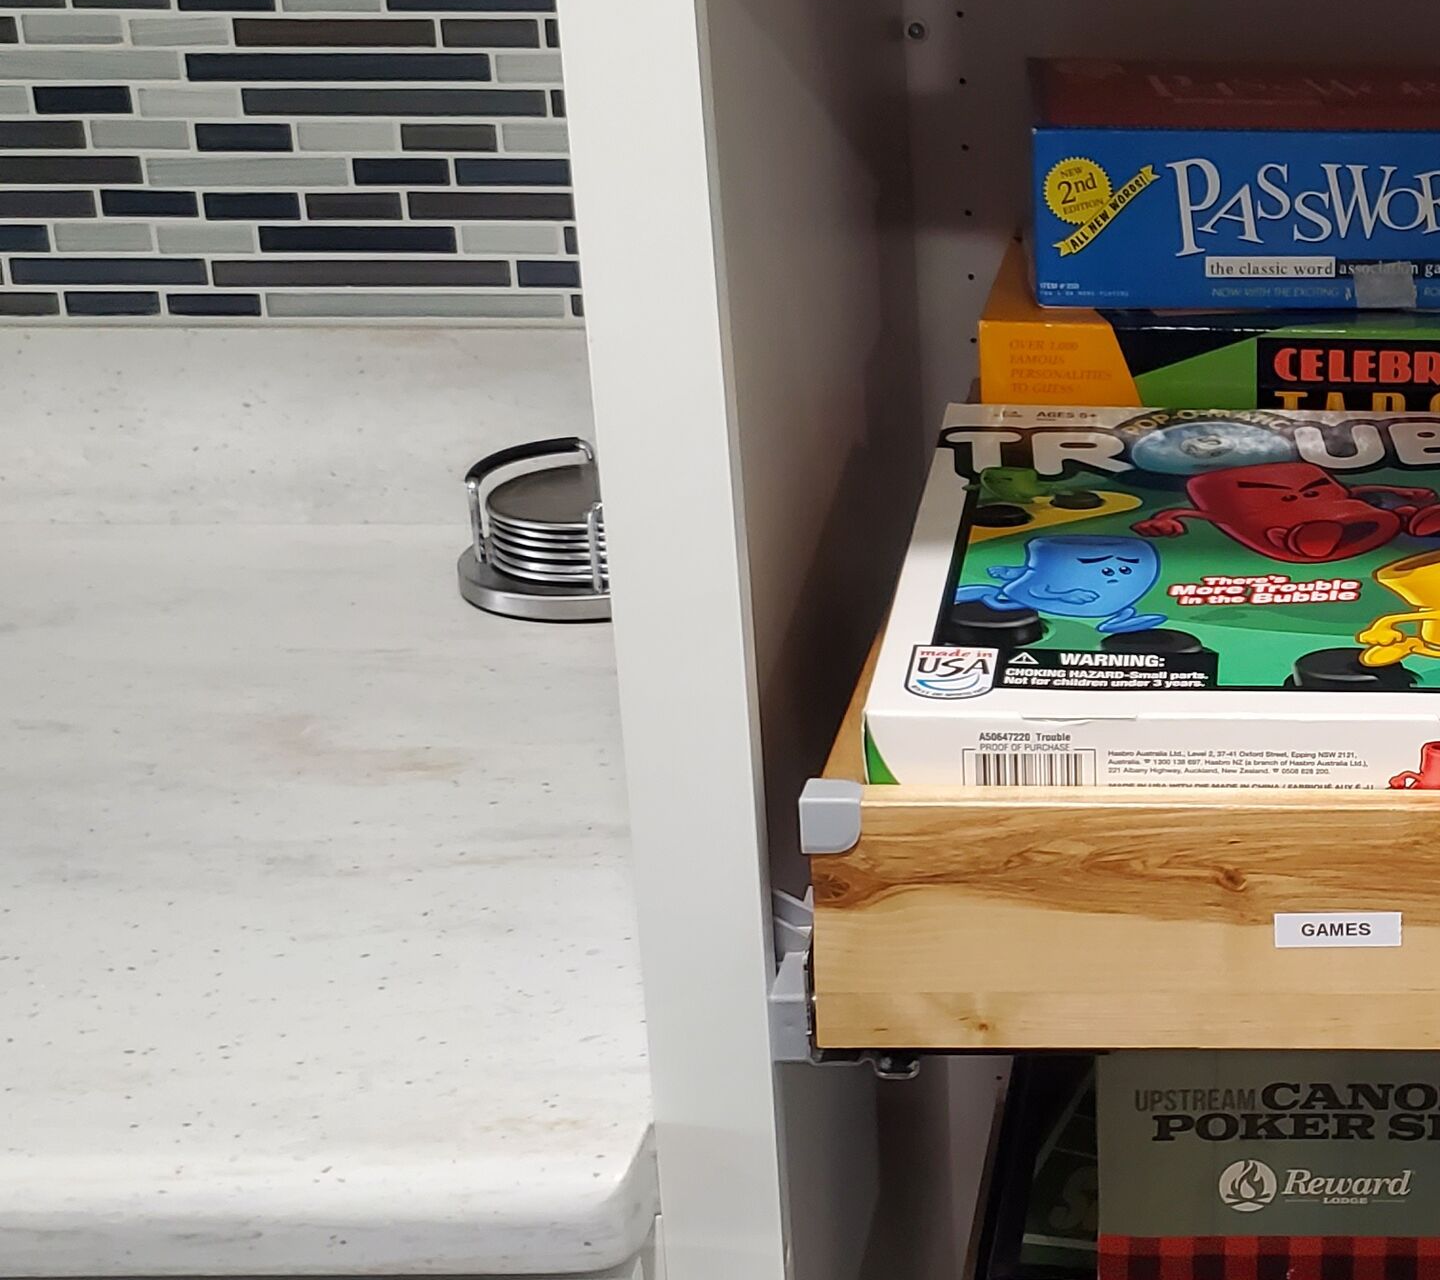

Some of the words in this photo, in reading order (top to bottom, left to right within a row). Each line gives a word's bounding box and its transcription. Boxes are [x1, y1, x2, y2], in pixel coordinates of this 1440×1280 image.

[1057, 172, 1097, 205] 2nd
[1063, 198, 1105, 215] EDITION
[1070, 231, 1089, 250] ALL
[1088, 210, 1110, 234] NEW
[1108, 175, 1147, 211] WORDS!
[1210, 262, 1234, 275] the
[1239, 262, 1289, 275] classic
[1293, 262, 1333, 275] word
[1036, 410, 1075, 419] AGES
[1203, 575, 1290, 586] There's
[1169, 585, 1244, 596] More
[1250, 580, 1361, 593] Trouble
[1180, 595, 1203, 605] in
[1208, 594, 1246, 604] the
[1251, 590, 1359, 604] Bubble
[919, 649, 971, 658] made
[975, 649, 992, 658] in
[1060, 653, 1165, 667] WARNING:
[917, 657, 990, 676] USA
[1005, 667, 1066, 678] CHOKING
[1170, 671, 1209, 681] parts.
[1003, 676, 1029, 686] Not
[1031, 676, 1051, 686] for
[1053, 677, 1107, 687] children
[1110, 678, 1150, 687] under
[1153, 679, 1162, 687] 3
[1164, 680, 1205, 689] years.
[1036, 732, 1070, 742] Trouble
[979, 743, 1010, 752] PROOF
[1012, 743, 1022, 752] OF
[1024, 743, 1070, 752] PURCHASE
[1301, 923, 1371, 937] GAMES
[1135, 1088, 1256, 1112] UPSTREAM
[1152, 1113, 1375, 1141] POKER
[1283, 1168, 1411, 1196] Reward
[1323, 1196, 1368, 1204] LODGE
